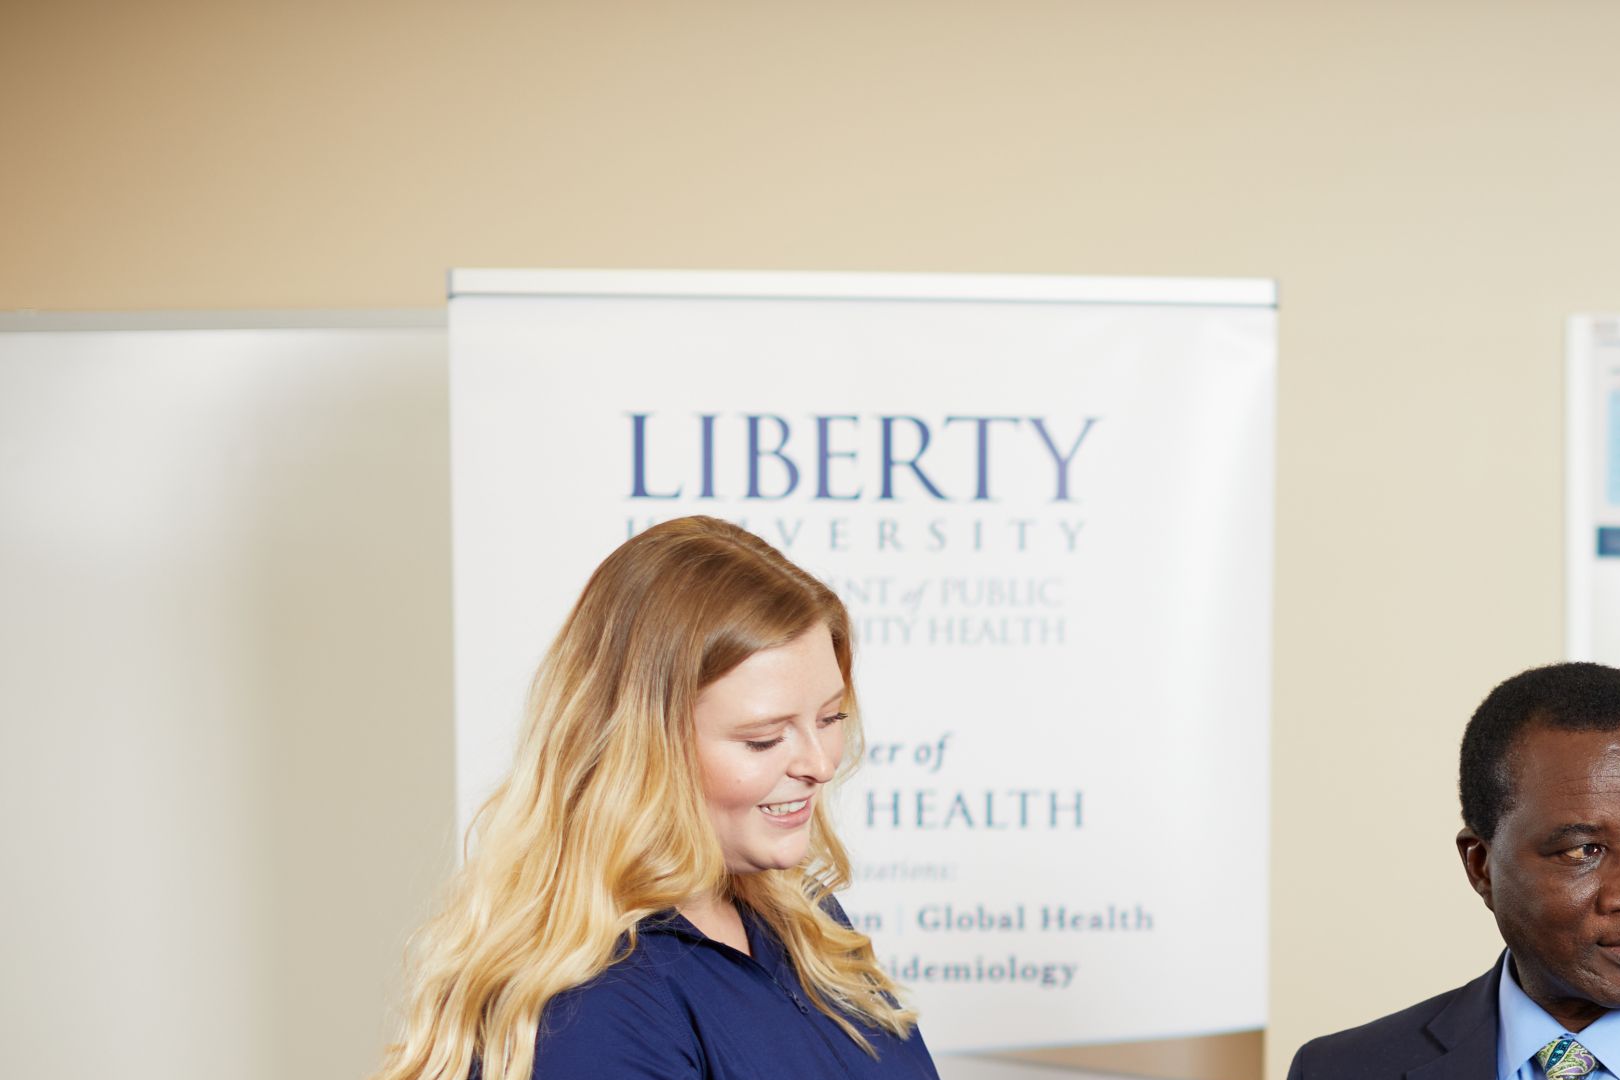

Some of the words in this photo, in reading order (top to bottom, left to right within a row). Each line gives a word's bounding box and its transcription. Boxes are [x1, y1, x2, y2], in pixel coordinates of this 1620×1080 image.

[625, 412, 1104, 502] LIBERTY
[626, 517, 1087, 552] VERSITY
[941, 576, 1065, 608] PUBLIC
[928, 616, 1067, 647] HEALTH
[913, 731, 956, 774] of
[865, 790, 1086, 829] HEALTH
[916, 902, 1026, 932] Global
[1040, 902, 1154, 932] Health
[888, 953, 1079, 990] idemiology
